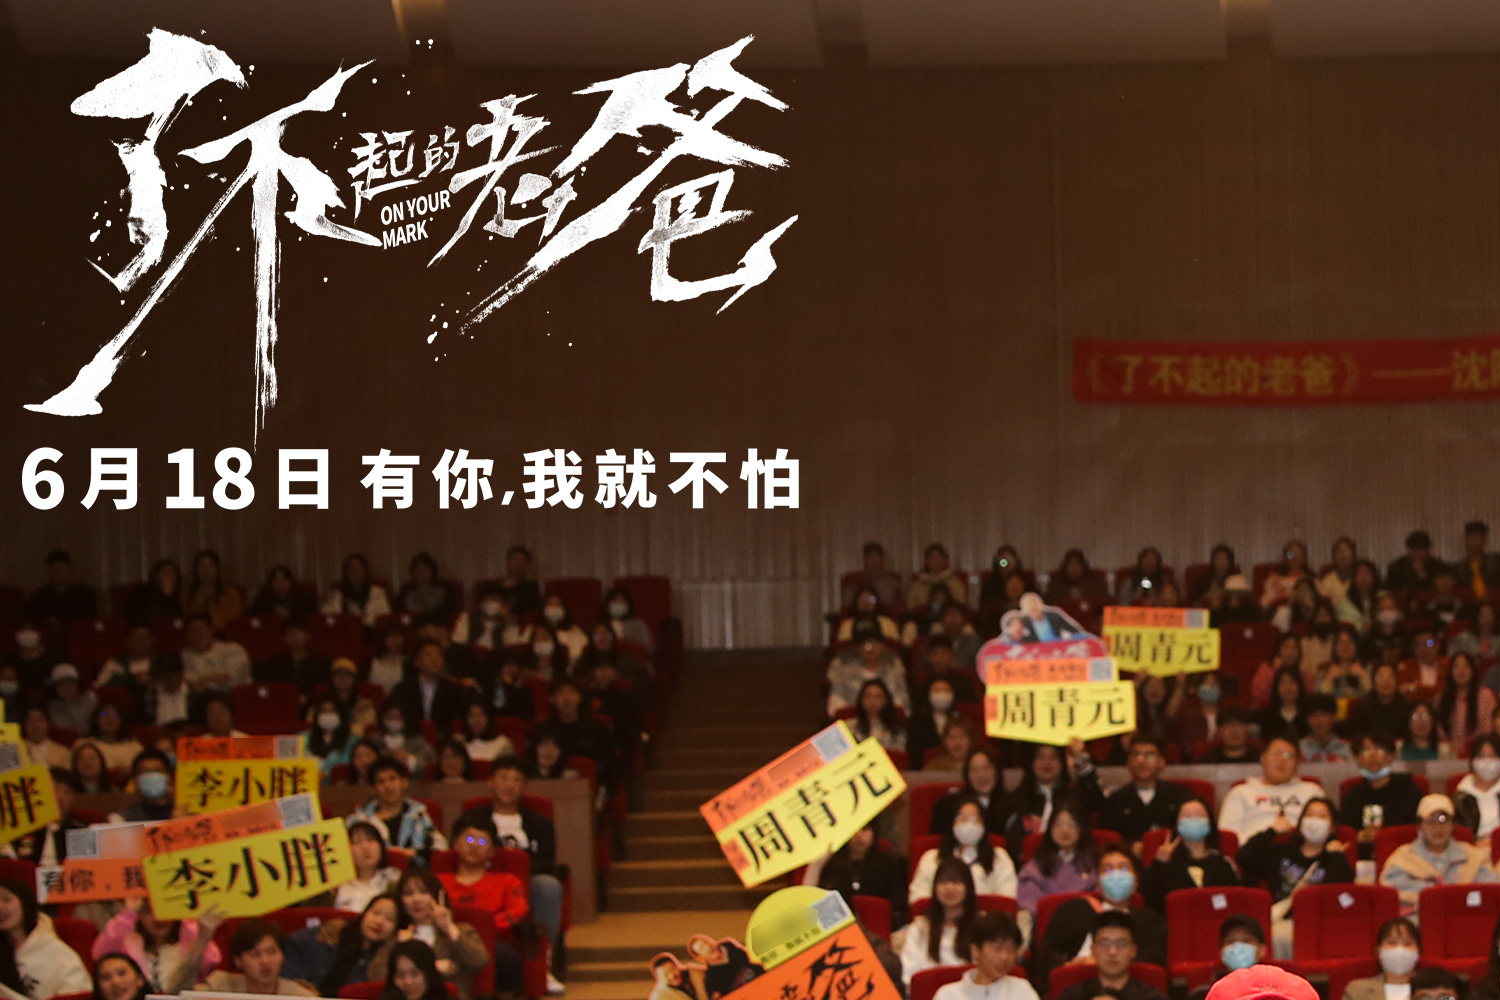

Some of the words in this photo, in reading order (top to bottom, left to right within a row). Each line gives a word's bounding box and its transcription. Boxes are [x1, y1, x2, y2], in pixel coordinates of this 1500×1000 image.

[1113, 631, 1212, 663] 周青元
[1001, 686, 1126, 729] 周青元
[189, 766, 309, 808] 李小胖
[739, 752, 893, 873] 周青元
[159, 831, 339, 911] 李小胖
